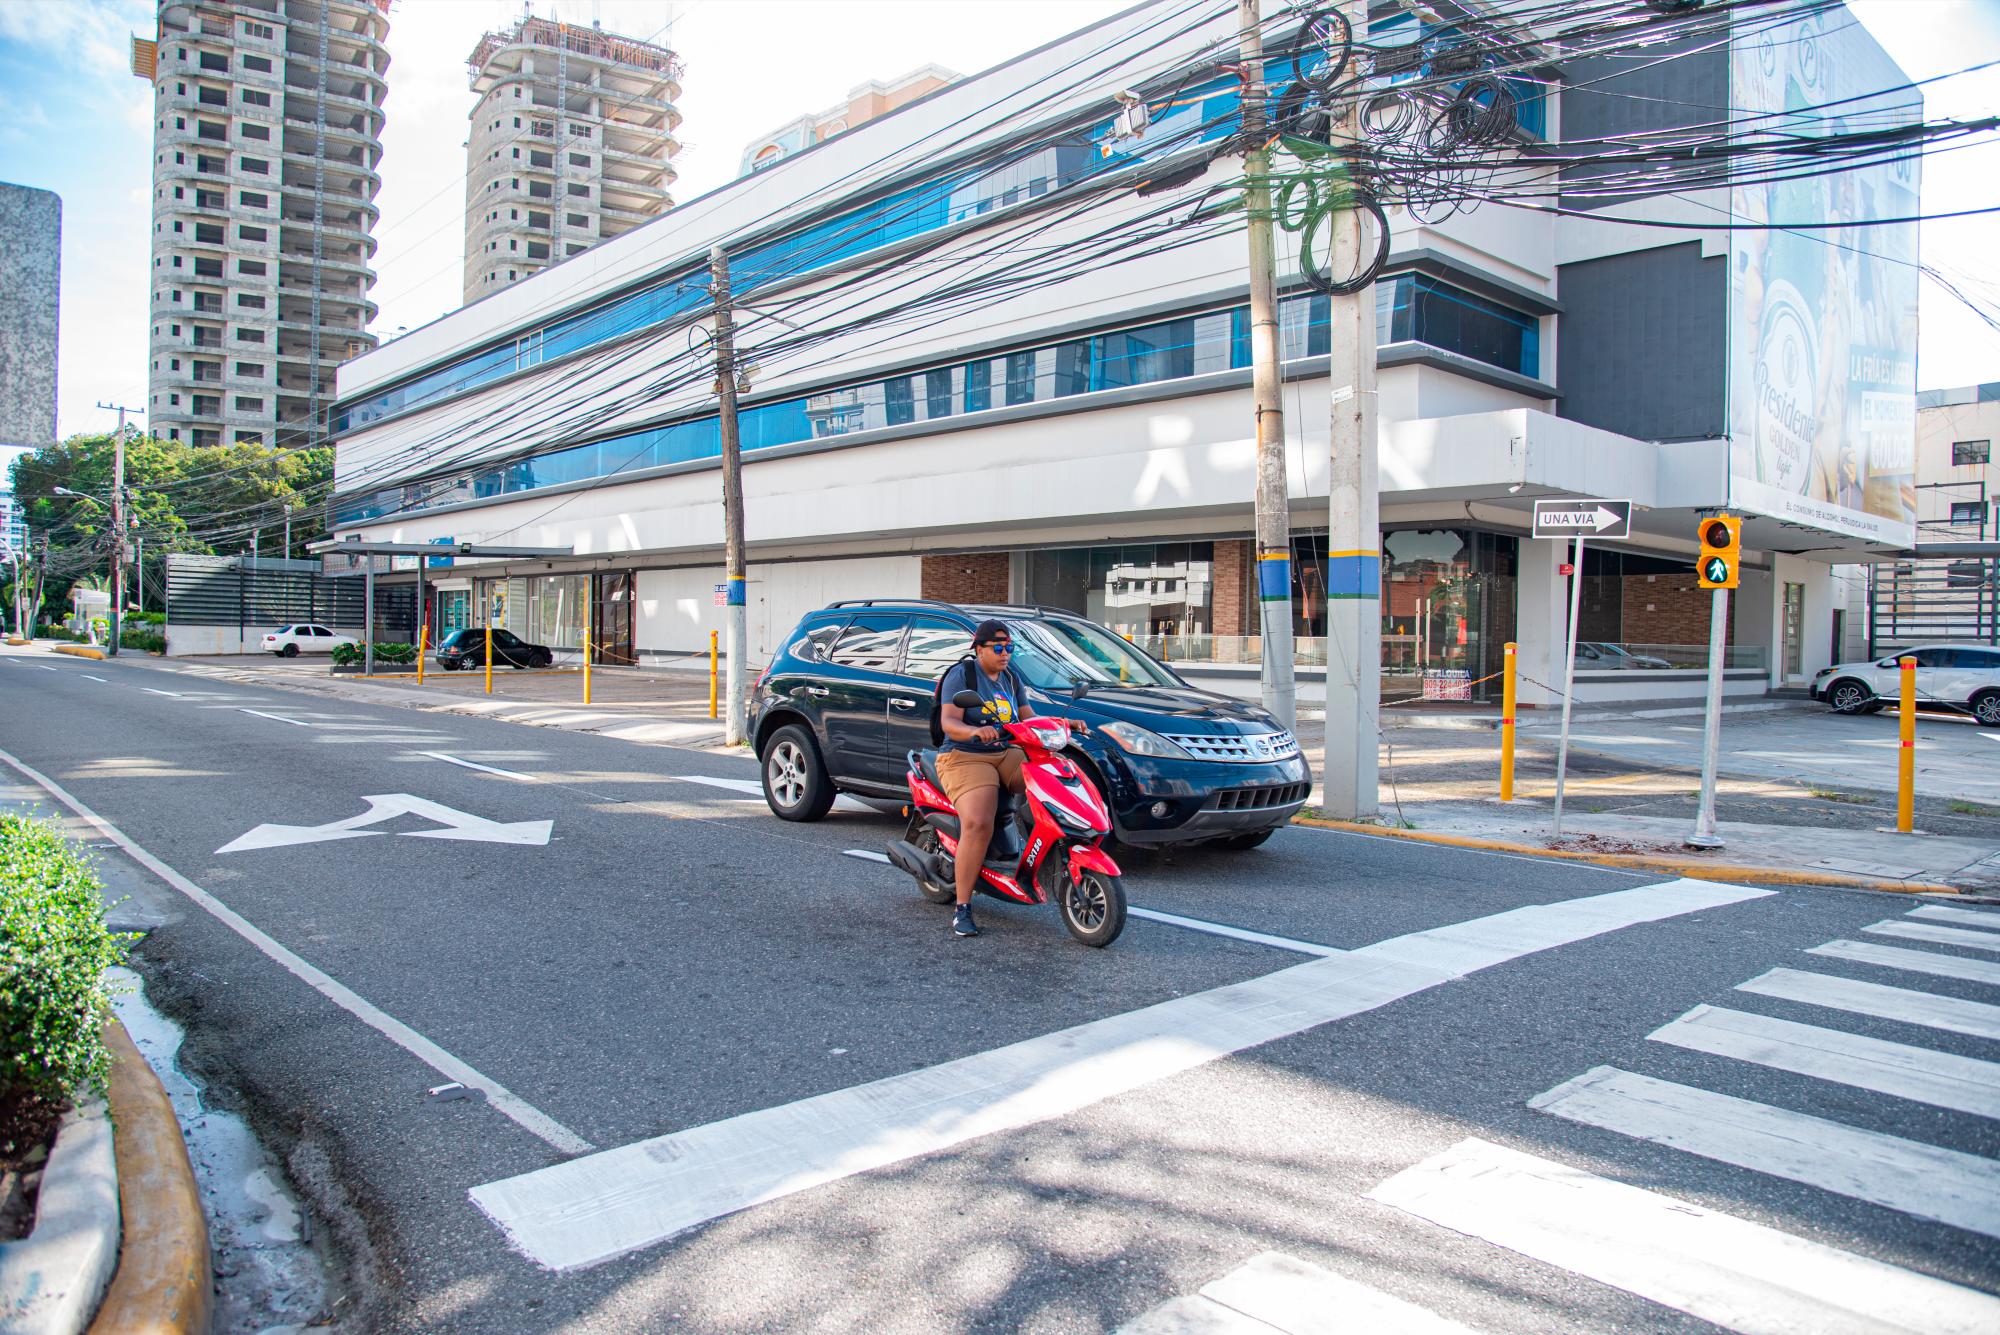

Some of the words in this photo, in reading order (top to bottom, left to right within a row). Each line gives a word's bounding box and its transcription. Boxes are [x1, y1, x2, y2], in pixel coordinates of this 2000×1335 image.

[1851, 354, 1861, 381] LA
[1758, 361, 1815, 443] Presidente
[1769, 424, 1800, 463] GOLDEN
[1777, 455, 1792, 480] light
[1544, 514, 1570, 524] UNA
[1573, 514, 1595, 524] VIA
[1424, 669, 1436, 678] SE
[1436, 669, 1470, 678] ALQUILA
